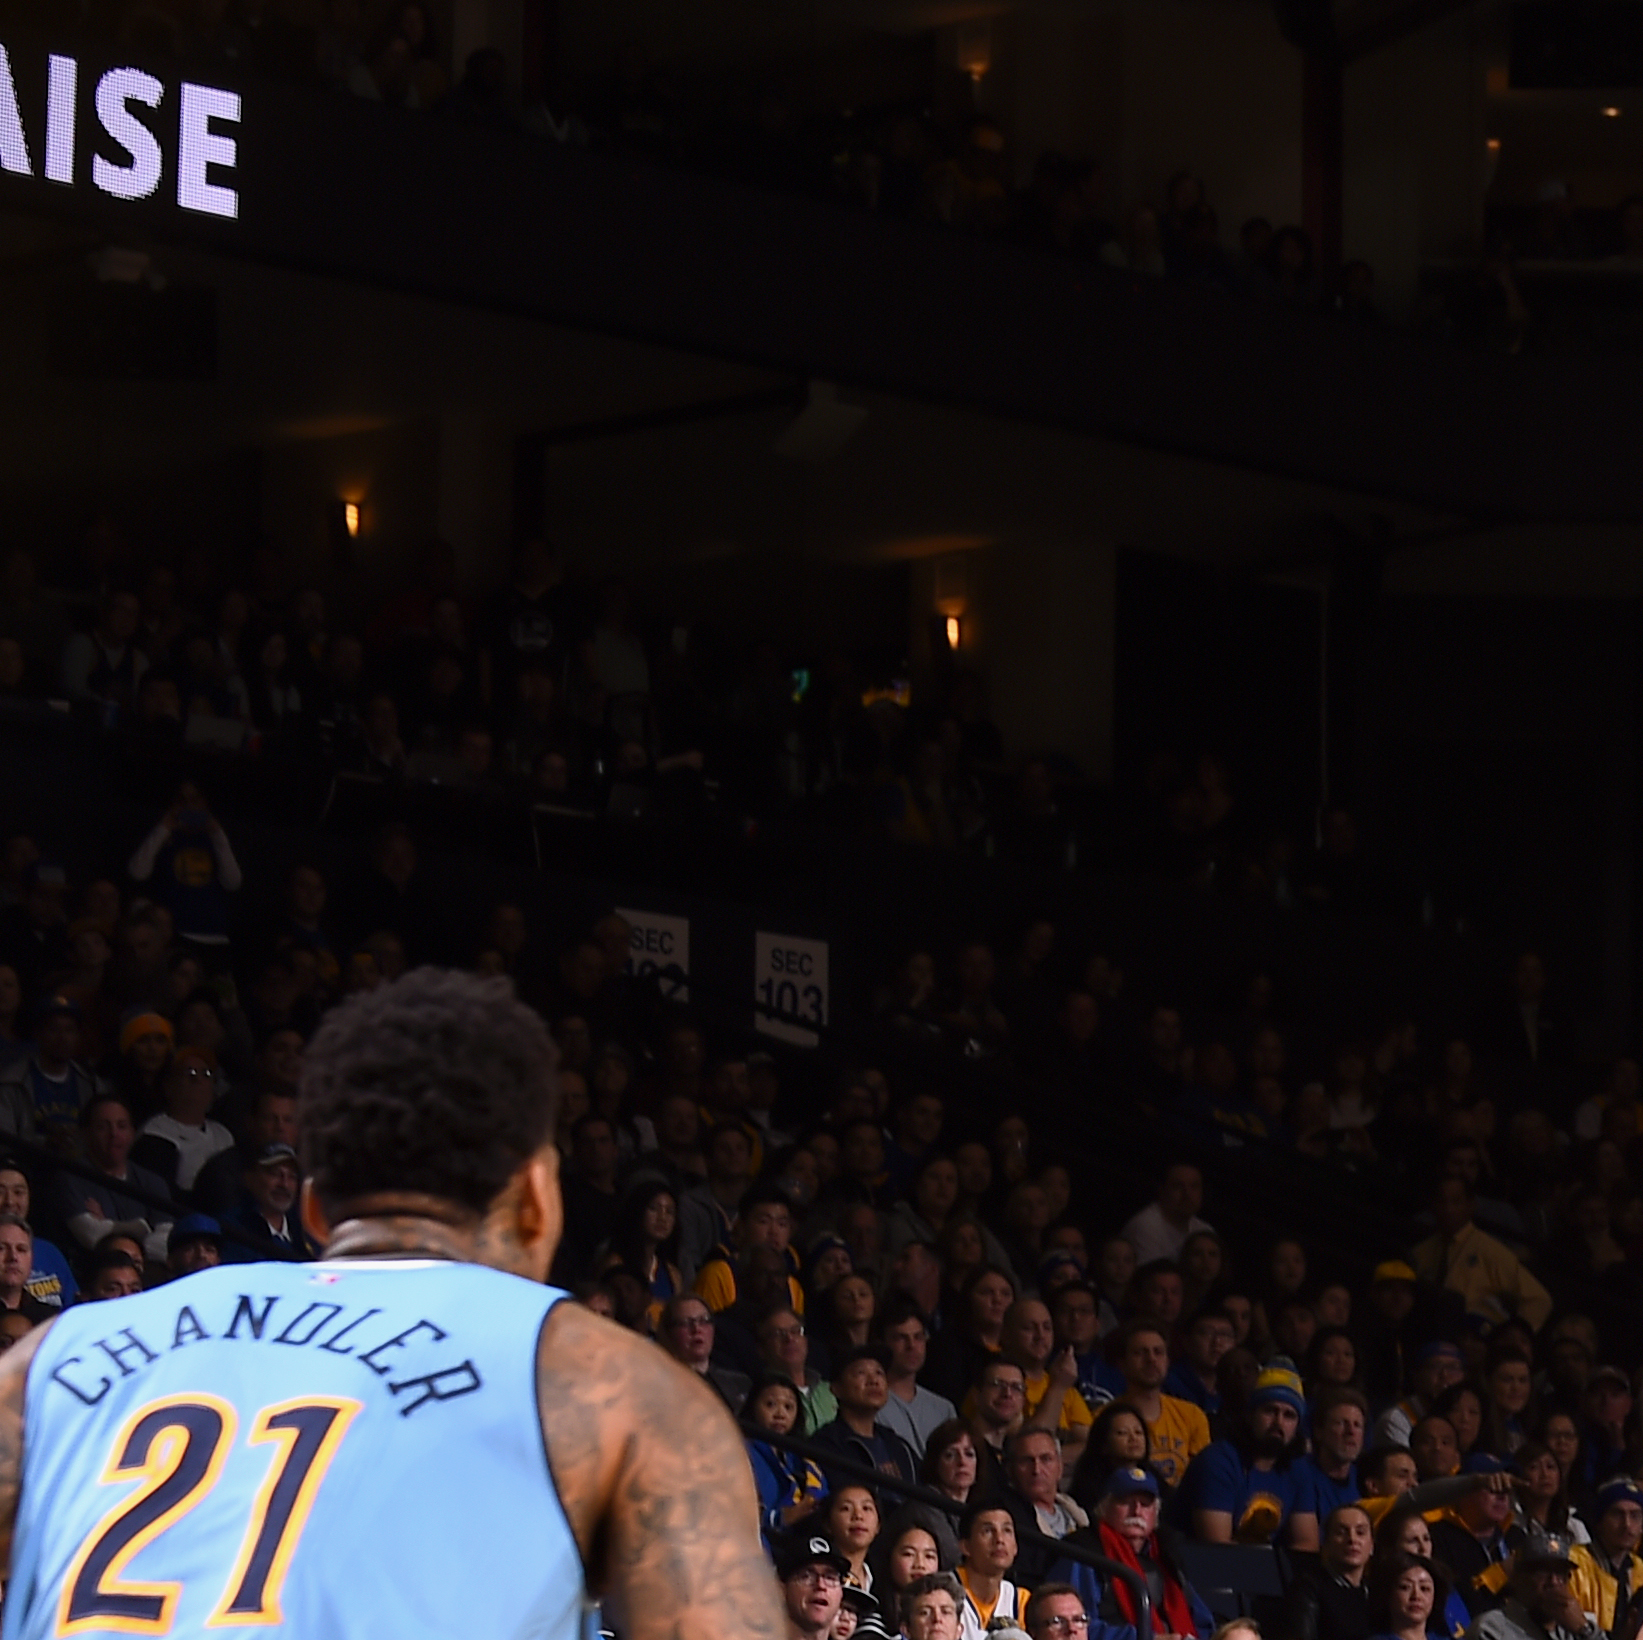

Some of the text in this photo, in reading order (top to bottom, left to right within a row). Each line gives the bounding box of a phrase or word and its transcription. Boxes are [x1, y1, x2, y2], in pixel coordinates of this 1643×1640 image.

[630, 926, 674, 955] SEC
[771, 947, 813, 977] SEC
[758, 977, 823, 1028] 103
[50, 1294, 482, 1417] CHANDLER
[55, 1391, 364, 1639] 21
